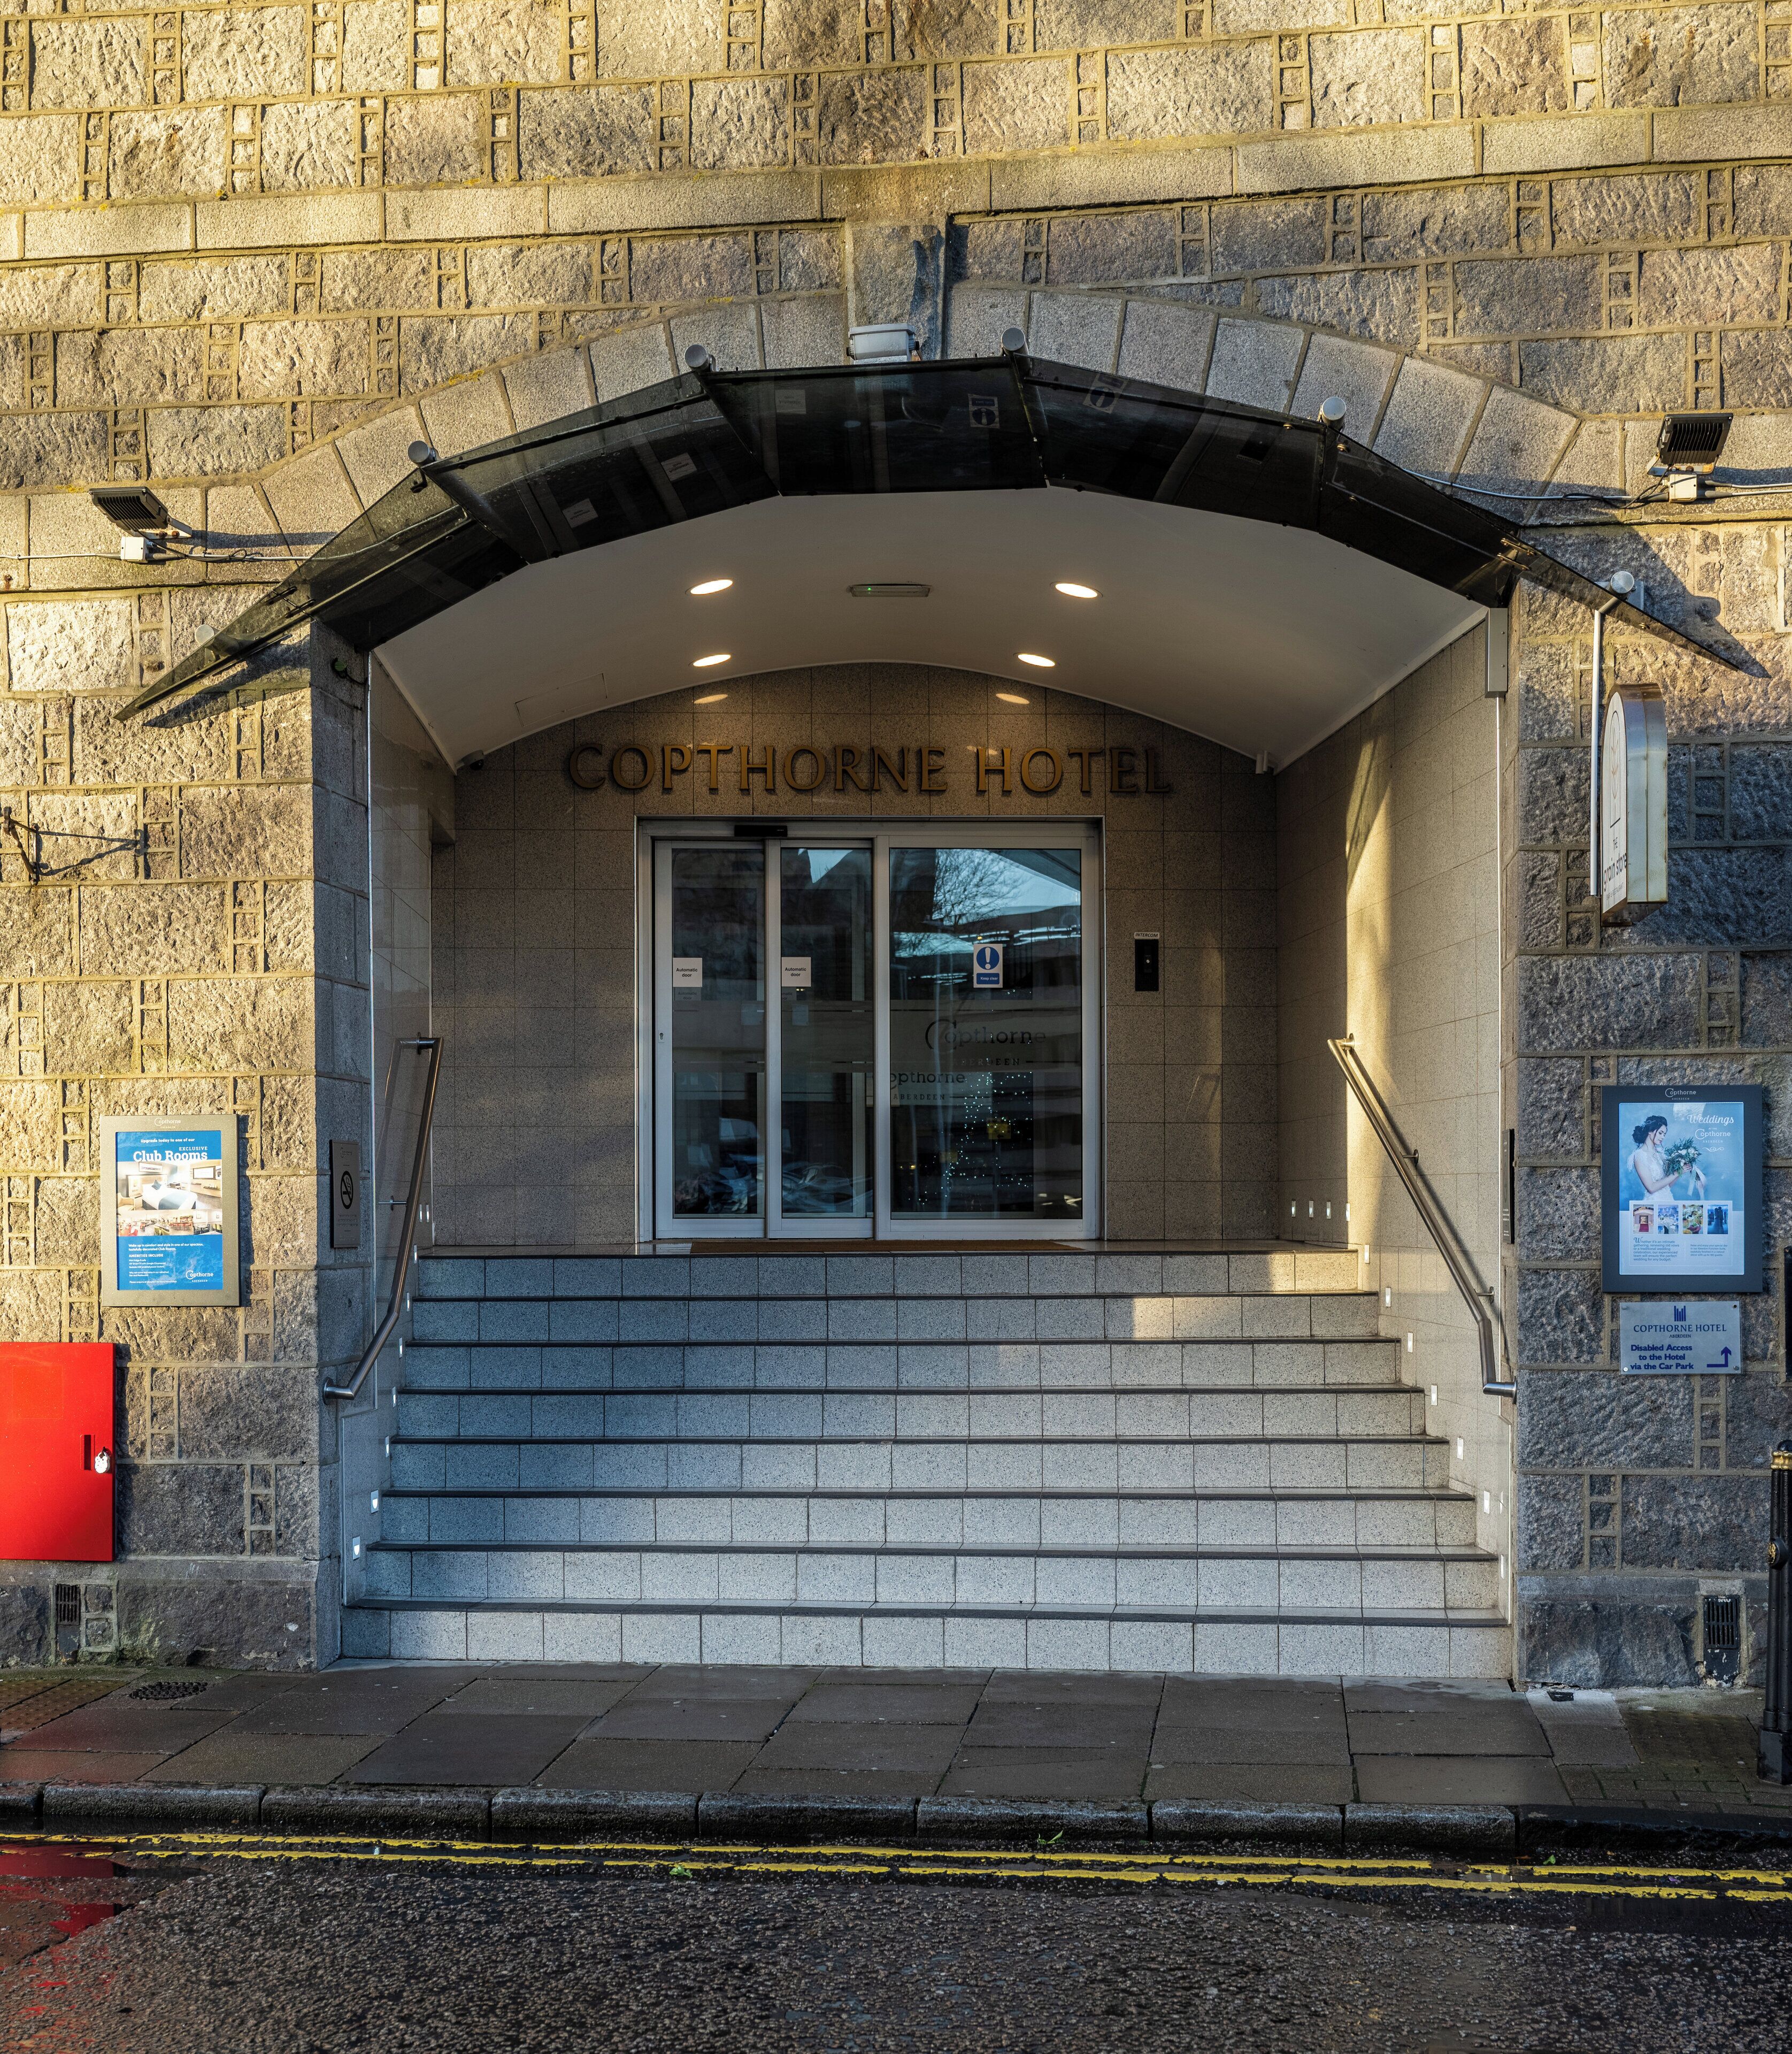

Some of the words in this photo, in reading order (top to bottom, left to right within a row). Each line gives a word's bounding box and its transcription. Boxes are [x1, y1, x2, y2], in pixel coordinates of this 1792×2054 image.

[570, 744, 947, 790] COPTHORNE
[978, 747, 1170, 793] HOTEL
[1604, 857, 1615, 892] grain
[1616, 852, 1626, 876] store
[925, 1018, 1046, 1049] Copthorne
[890, 1072, 965, 1090] opthorne
[1665, 1088, 1696, 1098] Copthorne
[155, 1117, 181, 1126] Copthorne
[1687, 1114, 1734, 1126] Weddings
[1695, 1129, 1731, 1139] Copthorne
[133, 1150, 162, 1162] Club
[165, 1151, 208, 1161] Rooms
[186, 1270, 214, 1279] Copthorne
[1633, 1324, 1693, 1332] COPTHORNE
[1695, 1324, 1727, 1332] HOTEL
